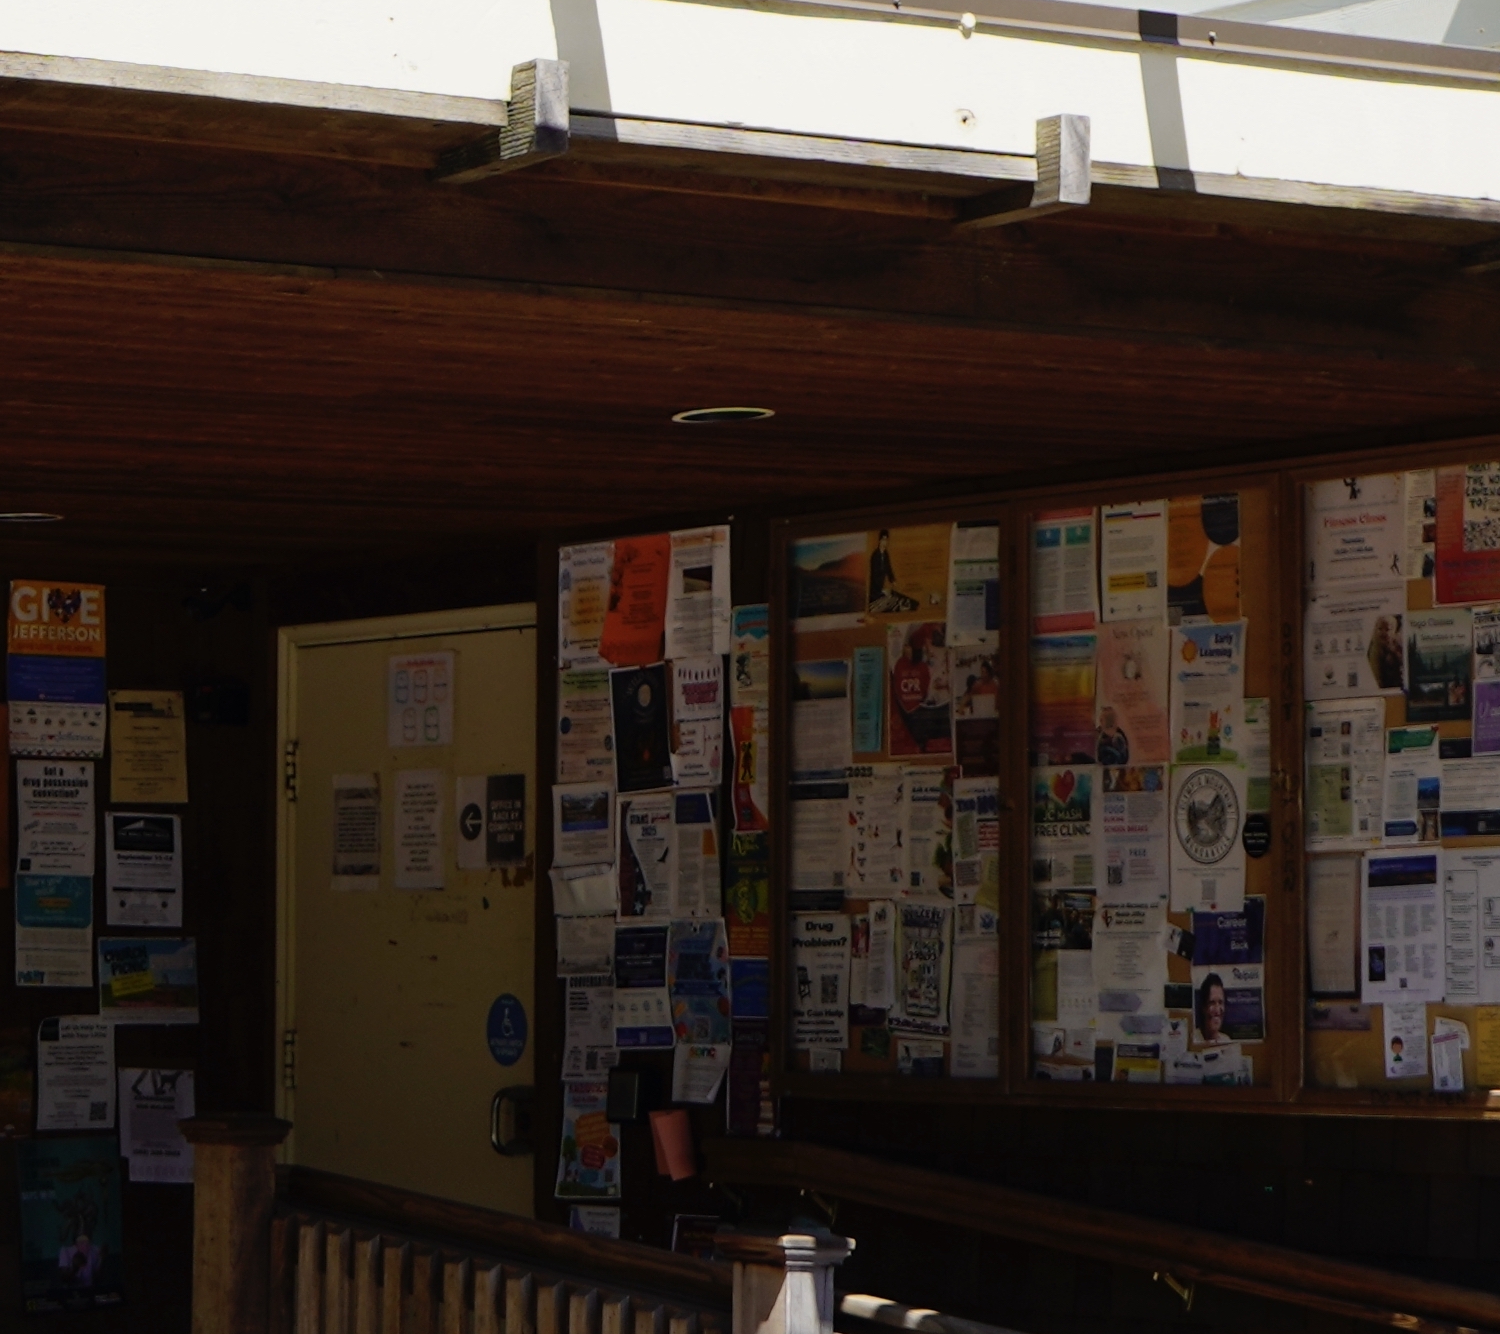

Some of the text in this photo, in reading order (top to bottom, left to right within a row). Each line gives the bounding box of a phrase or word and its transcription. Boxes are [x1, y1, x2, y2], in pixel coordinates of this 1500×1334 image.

[13, 624, 100, 642] JEFFERSON
[1214, 632, 1233, 645] Early
[1200, 647, 1232, 659] Learning
[901, 677, 921, 692] CPR
[23, 778, 88, 788] drug possession
[1034, 823, 1091, 837] FREE CLINIC
[805, 921, 834, 934] Drug
[1217, 917, 1248, 930] Career
[792, 935, 847, 948] Problem?
[1230, 940, 1249, 951] Back
